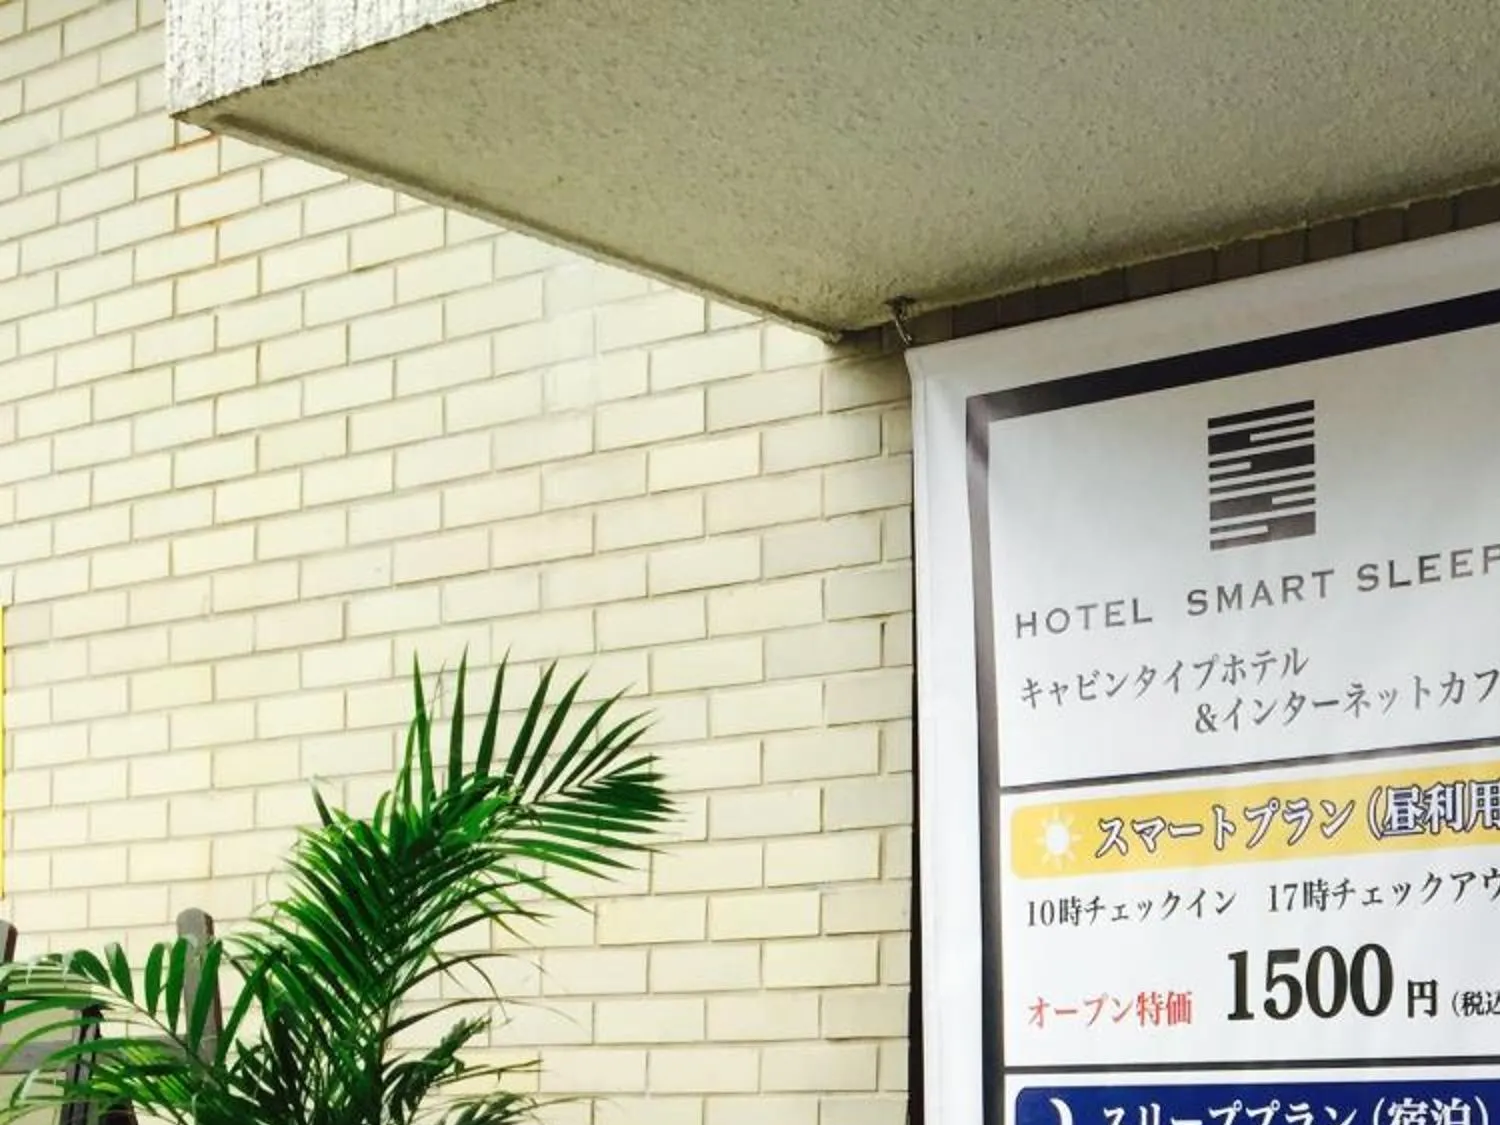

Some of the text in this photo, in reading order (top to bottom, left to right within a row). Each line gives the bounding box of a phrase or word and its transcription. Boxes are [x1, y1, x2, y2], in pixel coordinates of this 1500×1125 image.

[1015, 597, 1153, 639] HOTEL
[1186, 568, 1335, 617] SMART
[1020, 646, 1310, 709] キャビンタイプホテル
[1026, 887, 1237, 927] 10時チェックイン
[1028, 991, 1194, 1027] オープン特価
[1226, 942, 1395, 1022] 1500
[1406, 978, 1439, 1019] 円
